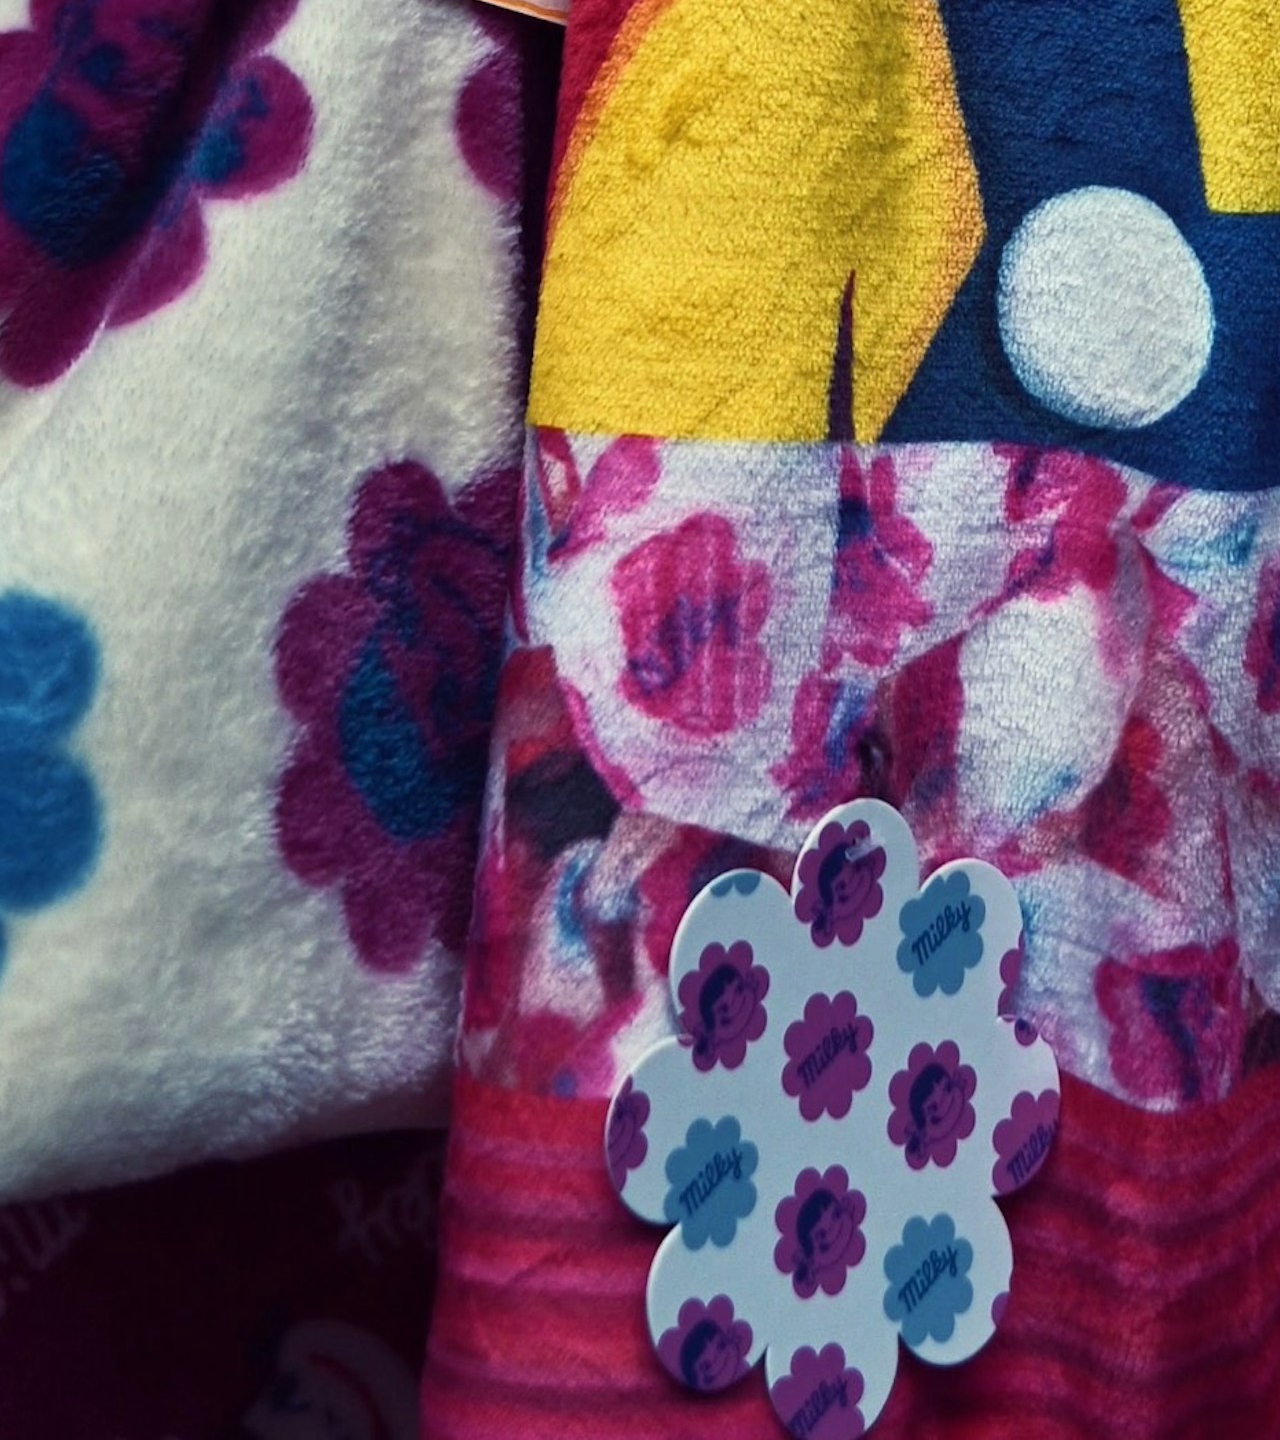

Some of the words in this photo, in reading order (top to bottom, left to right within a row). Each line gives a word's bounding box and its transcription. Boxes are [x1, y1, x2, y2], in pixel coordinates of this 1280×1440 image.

[911, 900, 971, 966] Milky
[797, 1023, 860, 1089] Milky
[678, 1147, 744, 1217] Milky
[898, 1245, 958, 1313] Milky
